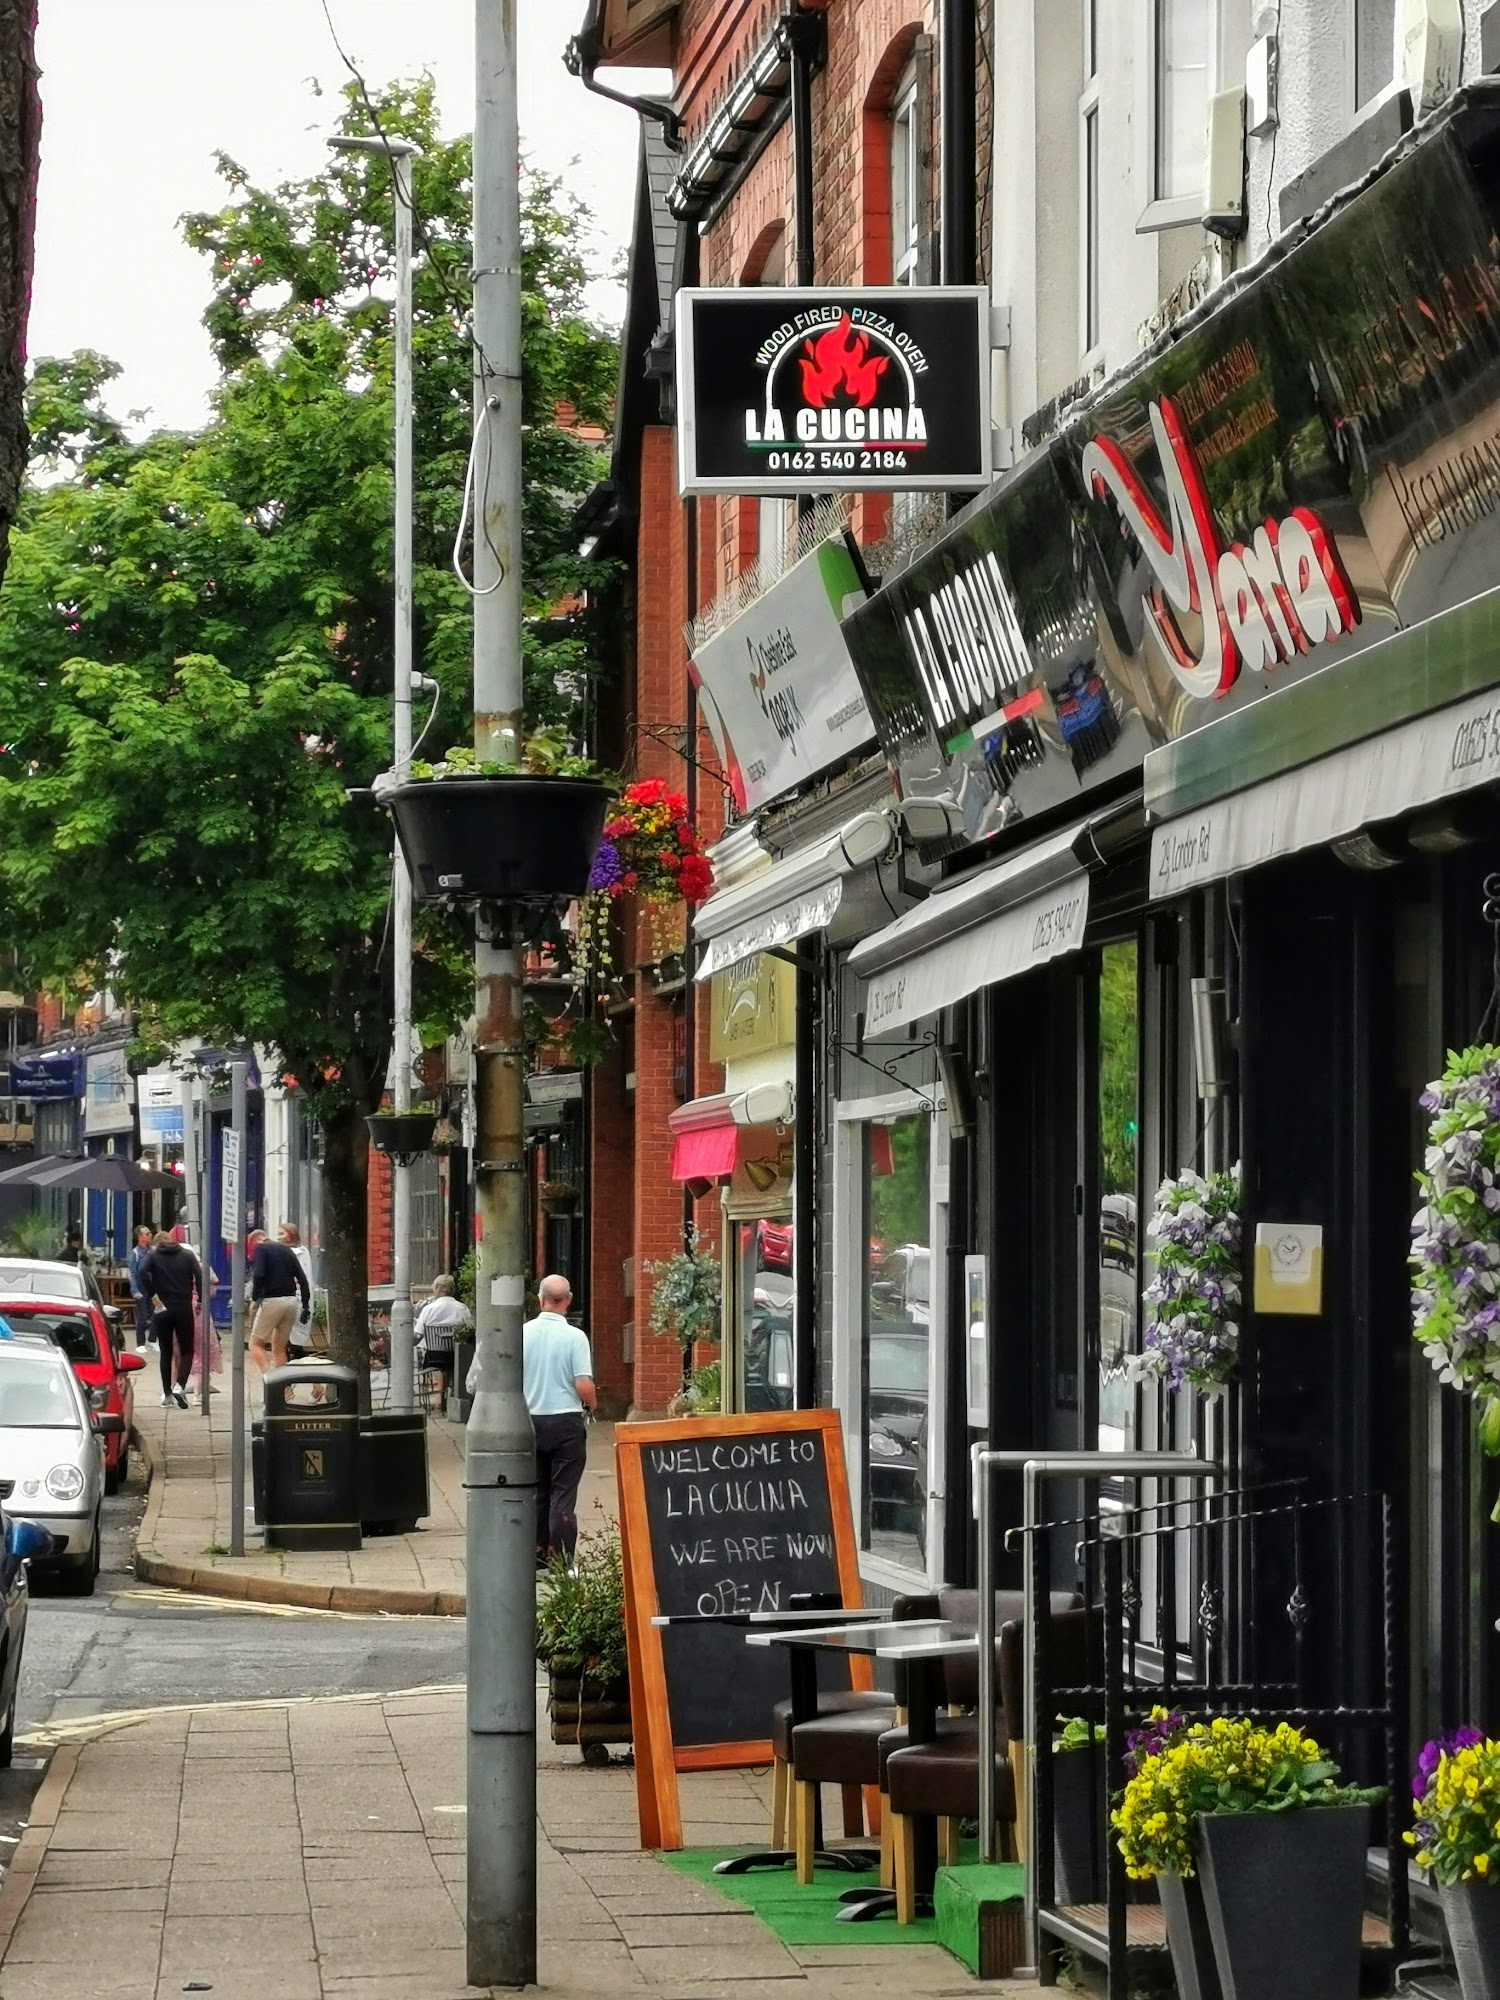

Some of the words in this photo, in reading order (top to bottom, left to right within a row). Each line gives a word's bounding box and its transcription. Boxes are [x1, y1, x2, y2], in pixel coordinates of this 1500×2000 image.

[755, 322, 795, 366] WOOD
[793, 305, 843, 330] FIRED
[851, 307, 896, 338] PIZZA
[895, 331, 930, 374] OVEN
[745, 408, 785, 442] LA
[796, 407, 927, 441] CUCINA
[768, 451, 815, 470] 0162
[820, 451, 855, 469] 540
[860, 450, 907, 469] 2184
[1082, 395, 1358, 699] Yara
[930, 550, 1033, 715] CUCINA
[905, 606, 957, 729] LA
[295, 1422, 331, 1430] LITTER
[651, 1441, 782, 1474] WELCOME
[670, 1539, 717, 1566] WE
[723, 1536, 778, 1564] ARE
[786, 1532, 832, 1560] NOW
[697, 1578, 782, 1617] OPEN
